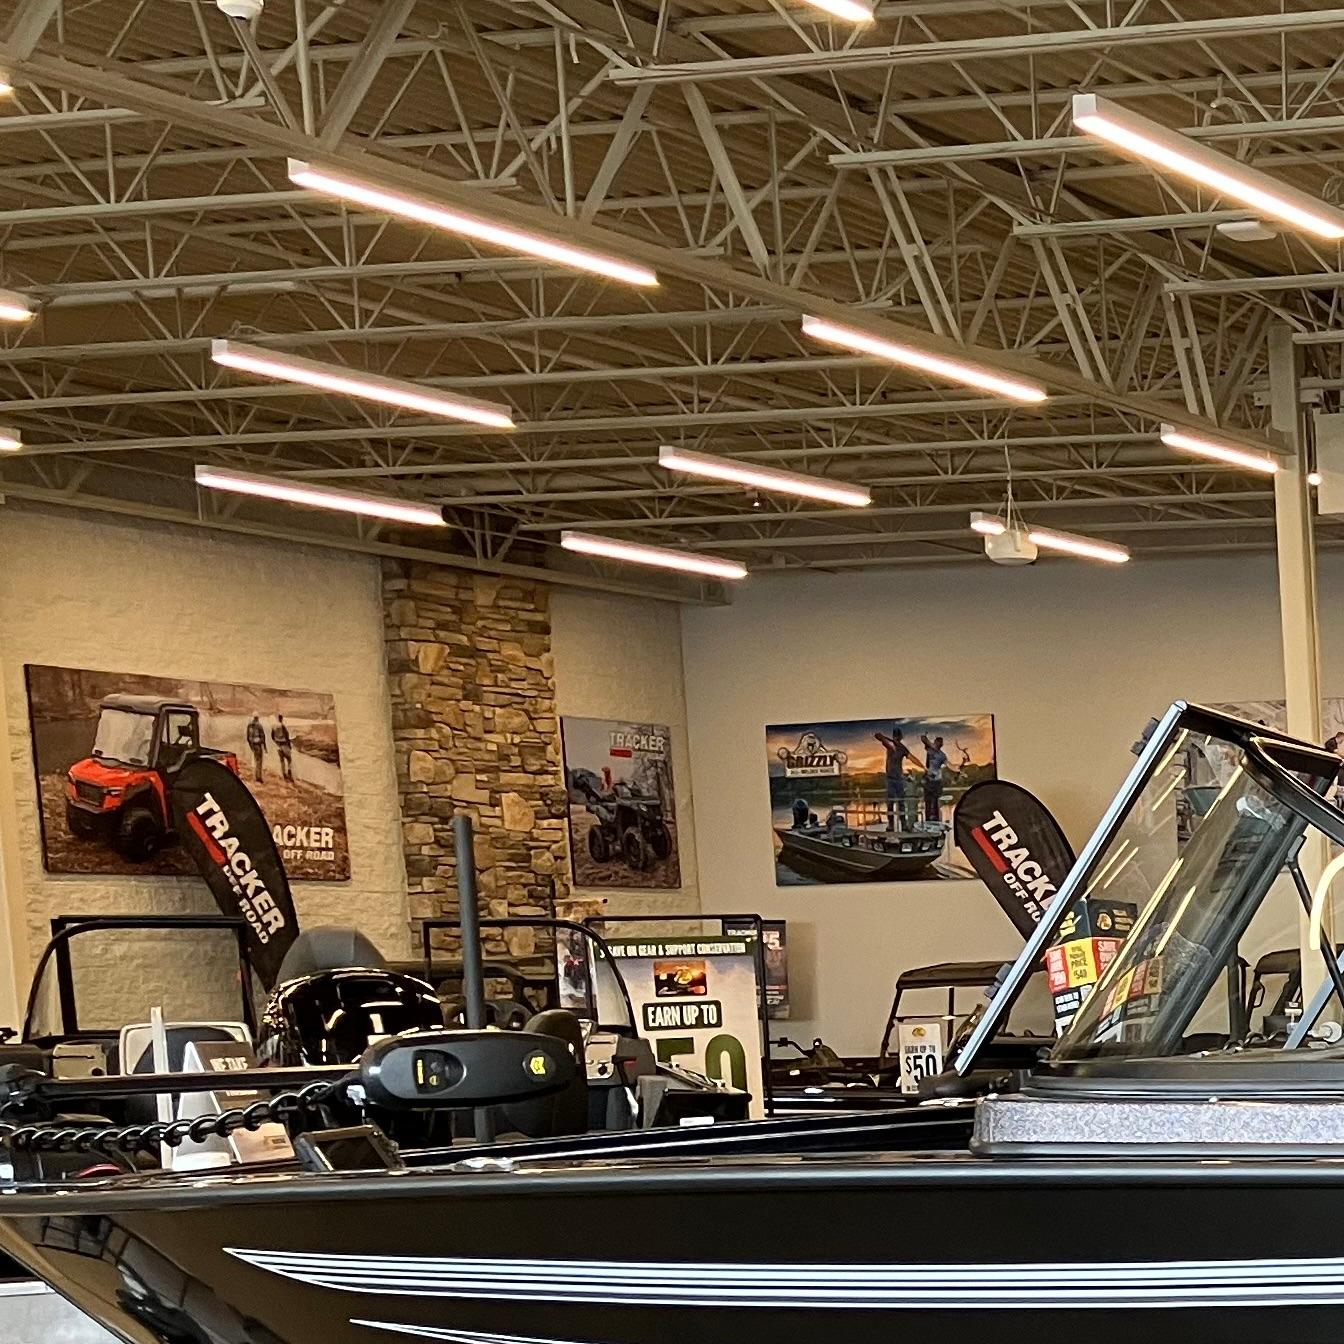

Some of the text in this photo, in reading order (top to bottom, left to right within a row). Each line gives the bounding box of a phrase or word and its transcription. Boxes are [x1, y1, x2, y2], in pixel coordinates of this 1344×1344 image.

[608, 732, 666, 751] TRACKER
[272, 824, 334, 849] ACKER
[195, 792, 285, 935] TRACKER
[283, 849, 335, 861] OFF ROAD
[982, 810, 1060, 911] TRACK
[1003, 872, 1029, 899] OFF
[238, 897, 269, 944] ROAD
[647, 1004, 717, 1027] EARN UP TO
[905, 1054, 938, 1084] $50
